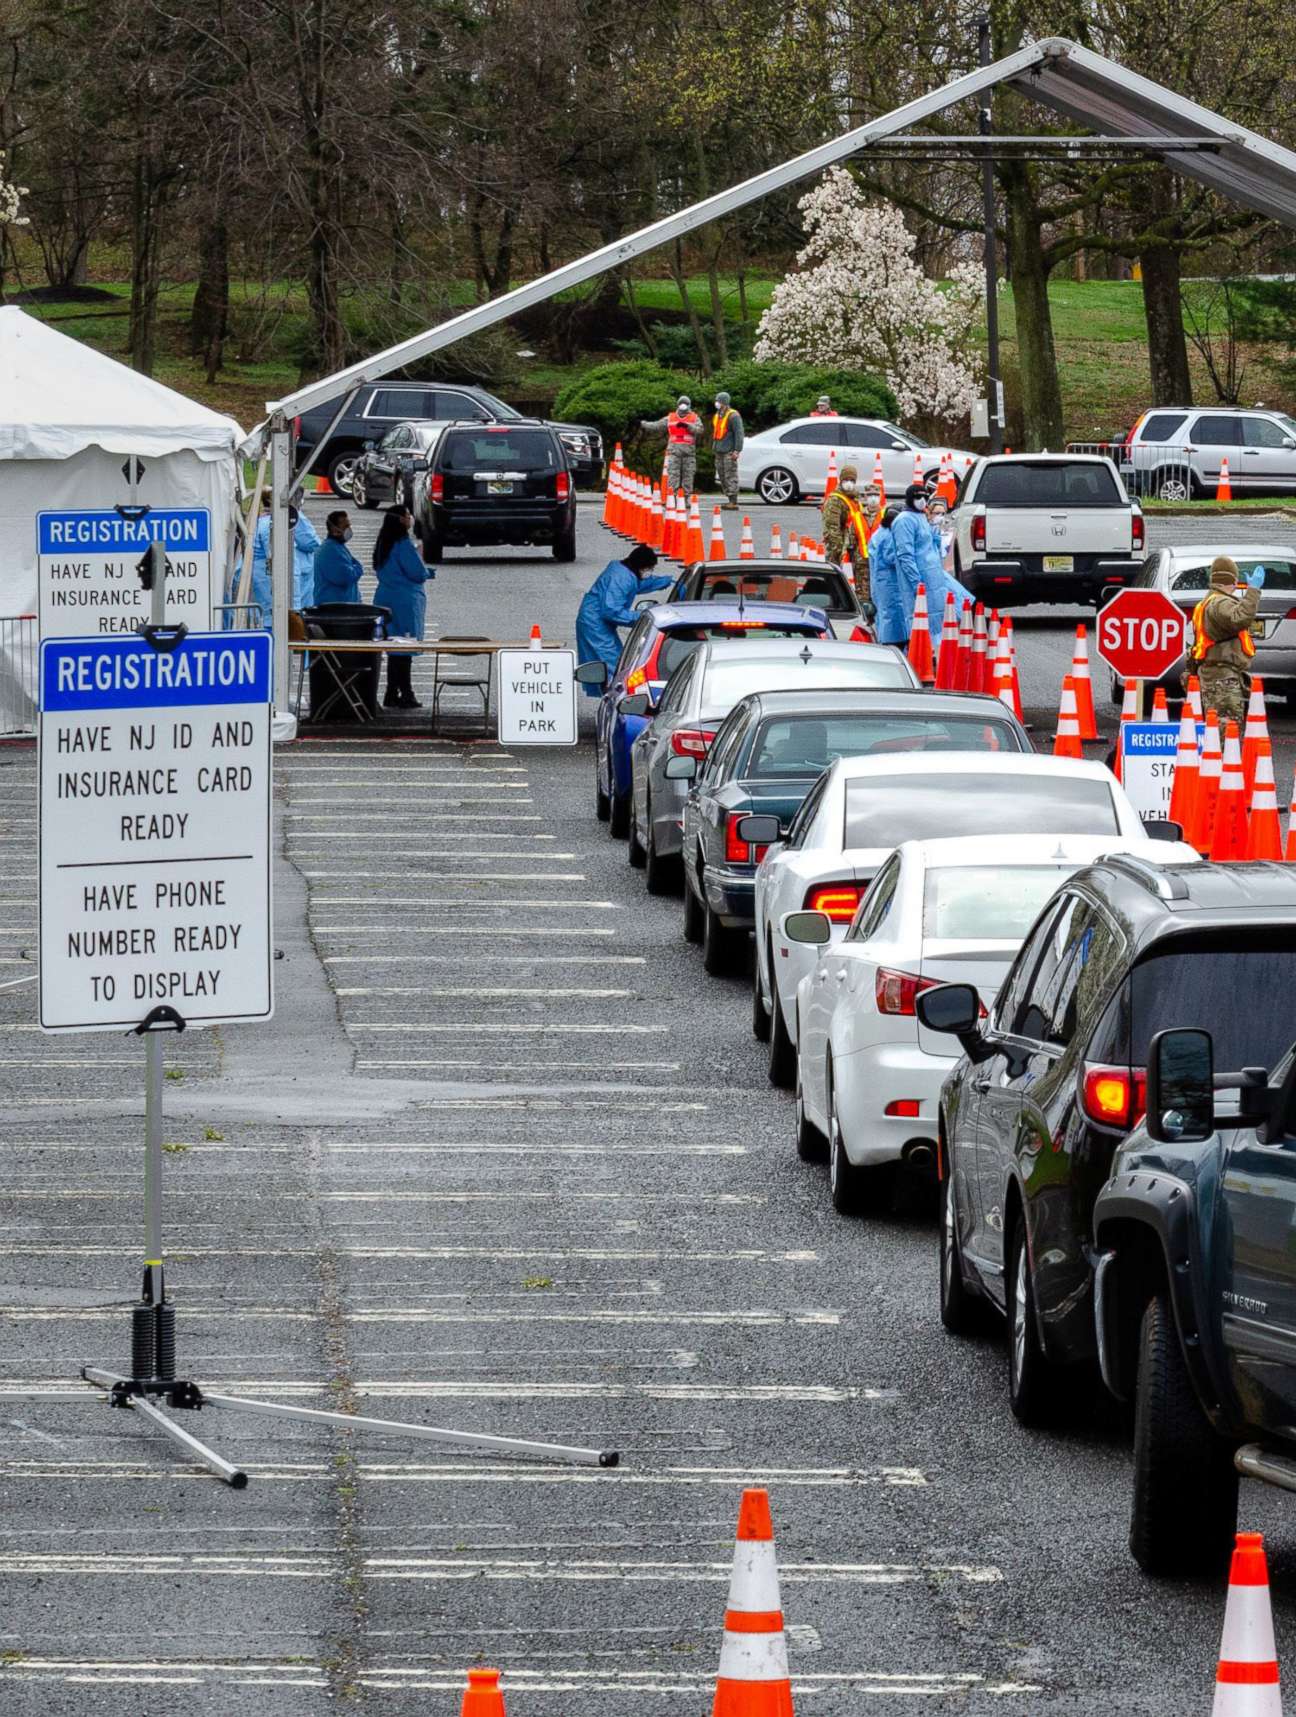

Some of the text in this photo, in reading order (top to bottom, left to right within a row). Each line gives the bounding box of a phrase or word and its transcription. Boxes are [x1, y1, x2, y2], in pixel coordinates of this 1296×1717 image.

[50, 519, 197, 543] REGISTRATION
[51, 563, 91, 579] HAVE
[104, 563, 124, 579] NJ
[51, 589, 197, 606] INSURANCE ARD
[99, 616, 150, 633] READY
[1103, 617, 1179, 651] STOP
[58, 650, 255, 692] REGISTRATION
[523, 662, 550, 674] PUT
[512, 682, 563, 694] VEHICLE
[530, 701, 545, 713] IN
[58, 721, 254, 754] HAVE NJ ID AND
[518, 720, 557, 732] PARK
[58, 766, 252, 799] INSURANCE CARD
[121, 813, 189, 841] READY
[84, 880, 226, 912] HAVE PHONE
[68, 924, 242, 958] NUMBER READY
[91, 970, 221, 1002] TO DISPLAY
